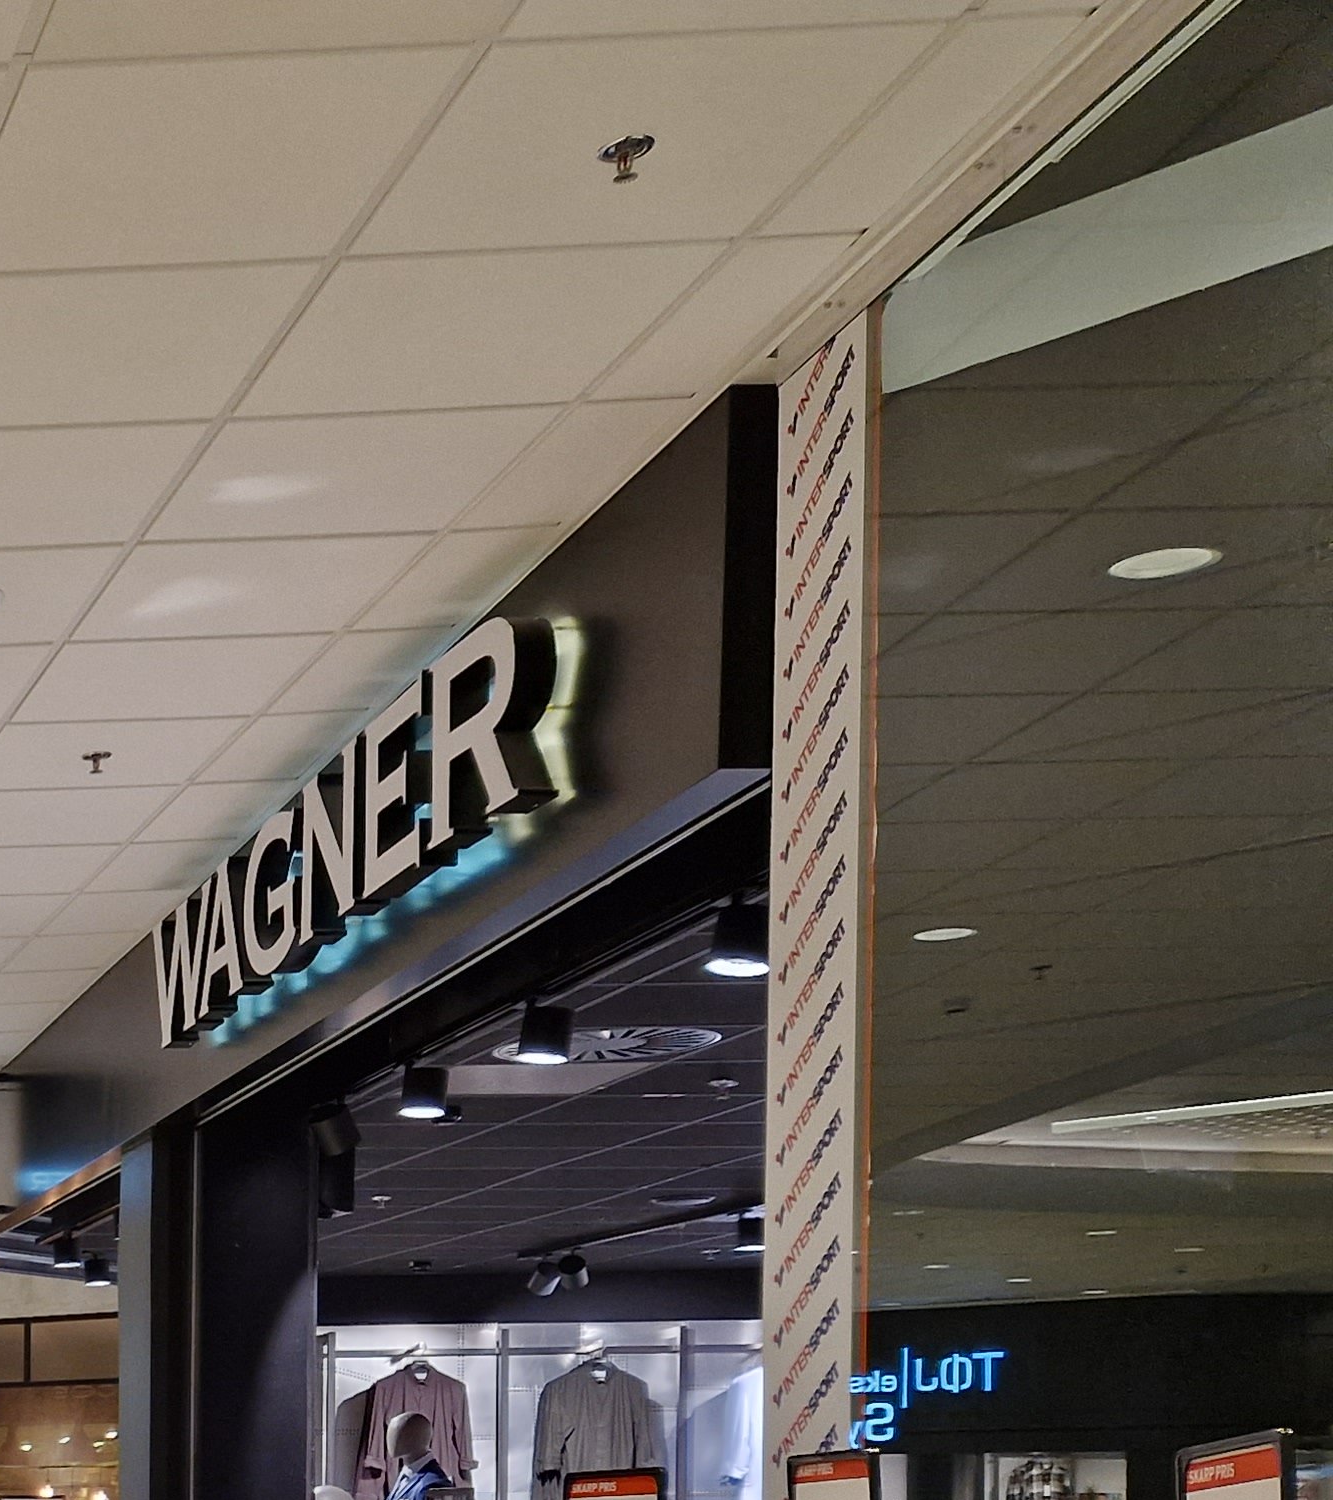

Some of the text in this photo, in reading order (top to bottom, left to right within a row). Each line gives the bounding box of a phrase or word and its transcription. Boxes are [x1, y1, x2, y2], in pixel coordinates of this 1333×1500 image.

[796, 335, 836, 416] INTERS
[796, 343, 856, 477] INTERSPORT
[795, 407, 855, 541] INTERSPORT
[794, 471, 853, 601] INTERSPORT
[793, 535, 852, 663] INTERSPORT
[792, 599, 851, 725] INTERSPORT
[790, 663, 850, 786] INTERSPORT
[152, 616, 520, 1049] WAGNER
[789, 727, 849, 847] INTERSPORT
[788, 790, 848, 909] INTERSPORT
[787, 854, 847, 970] INTERSPORT
[786, 917, 846, 1031] INTERSPORT
[785, 981, 845, 1091] INTERSPORT
[784, 1044, 844, 1152] INTERSPORT
[784, 1107, 843, 1214] INTERSPORT
[783, 1171, 843, 1275] INTERSPORT
[783, 1235, 842, 1335] INTERSPORT
[782, 1298, 841, 1396] INTERSPORT
[781, 1361, 840, 1457] INTERSPORT
[598, 1481, 617, 1492] PRIS
[1188, 1462, 1235, 1486] SKARP PRIS
